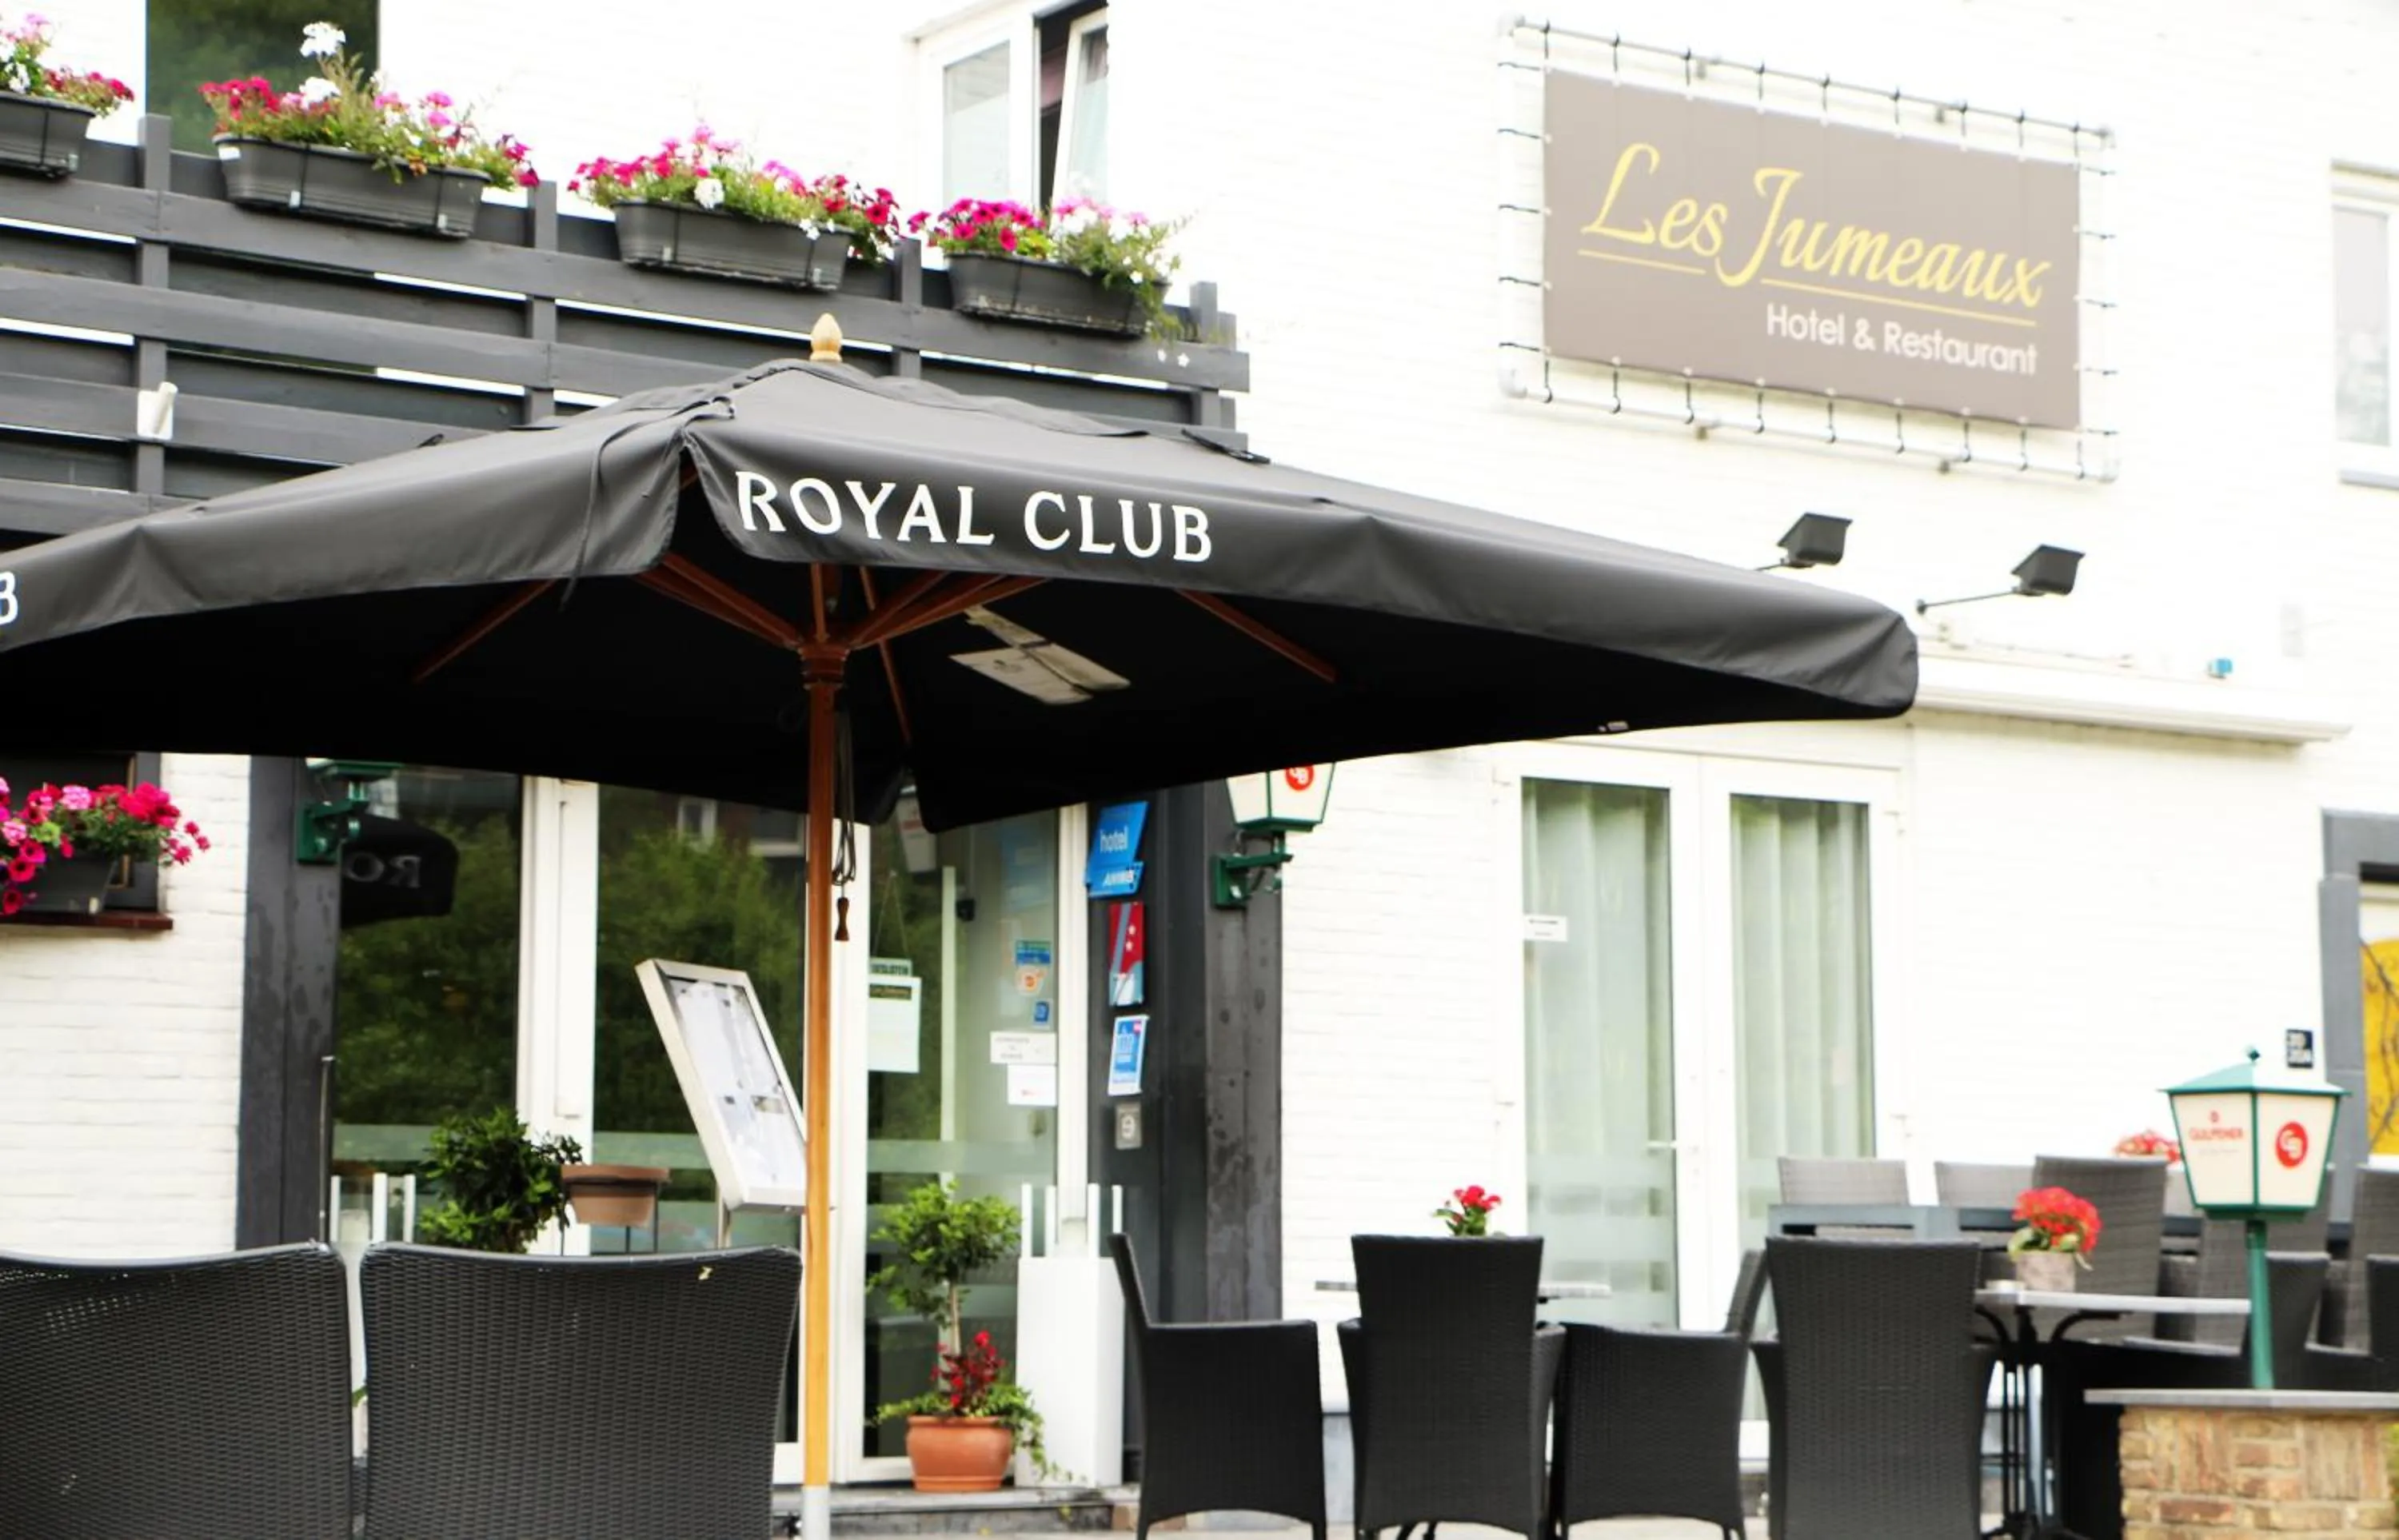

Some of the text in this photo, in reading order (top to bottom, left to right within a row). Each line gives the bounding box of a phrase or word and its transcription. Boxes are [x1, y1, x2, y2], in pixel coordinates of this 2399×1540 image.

[1580, 142, 2052, 308] Les Jumeaux
[1766, 302, 2038, 376] Hotel & Restaurant
[735, 470, 1212, 561] ROYAL CLUB
[1100, 825, 1128, 853] hotel
